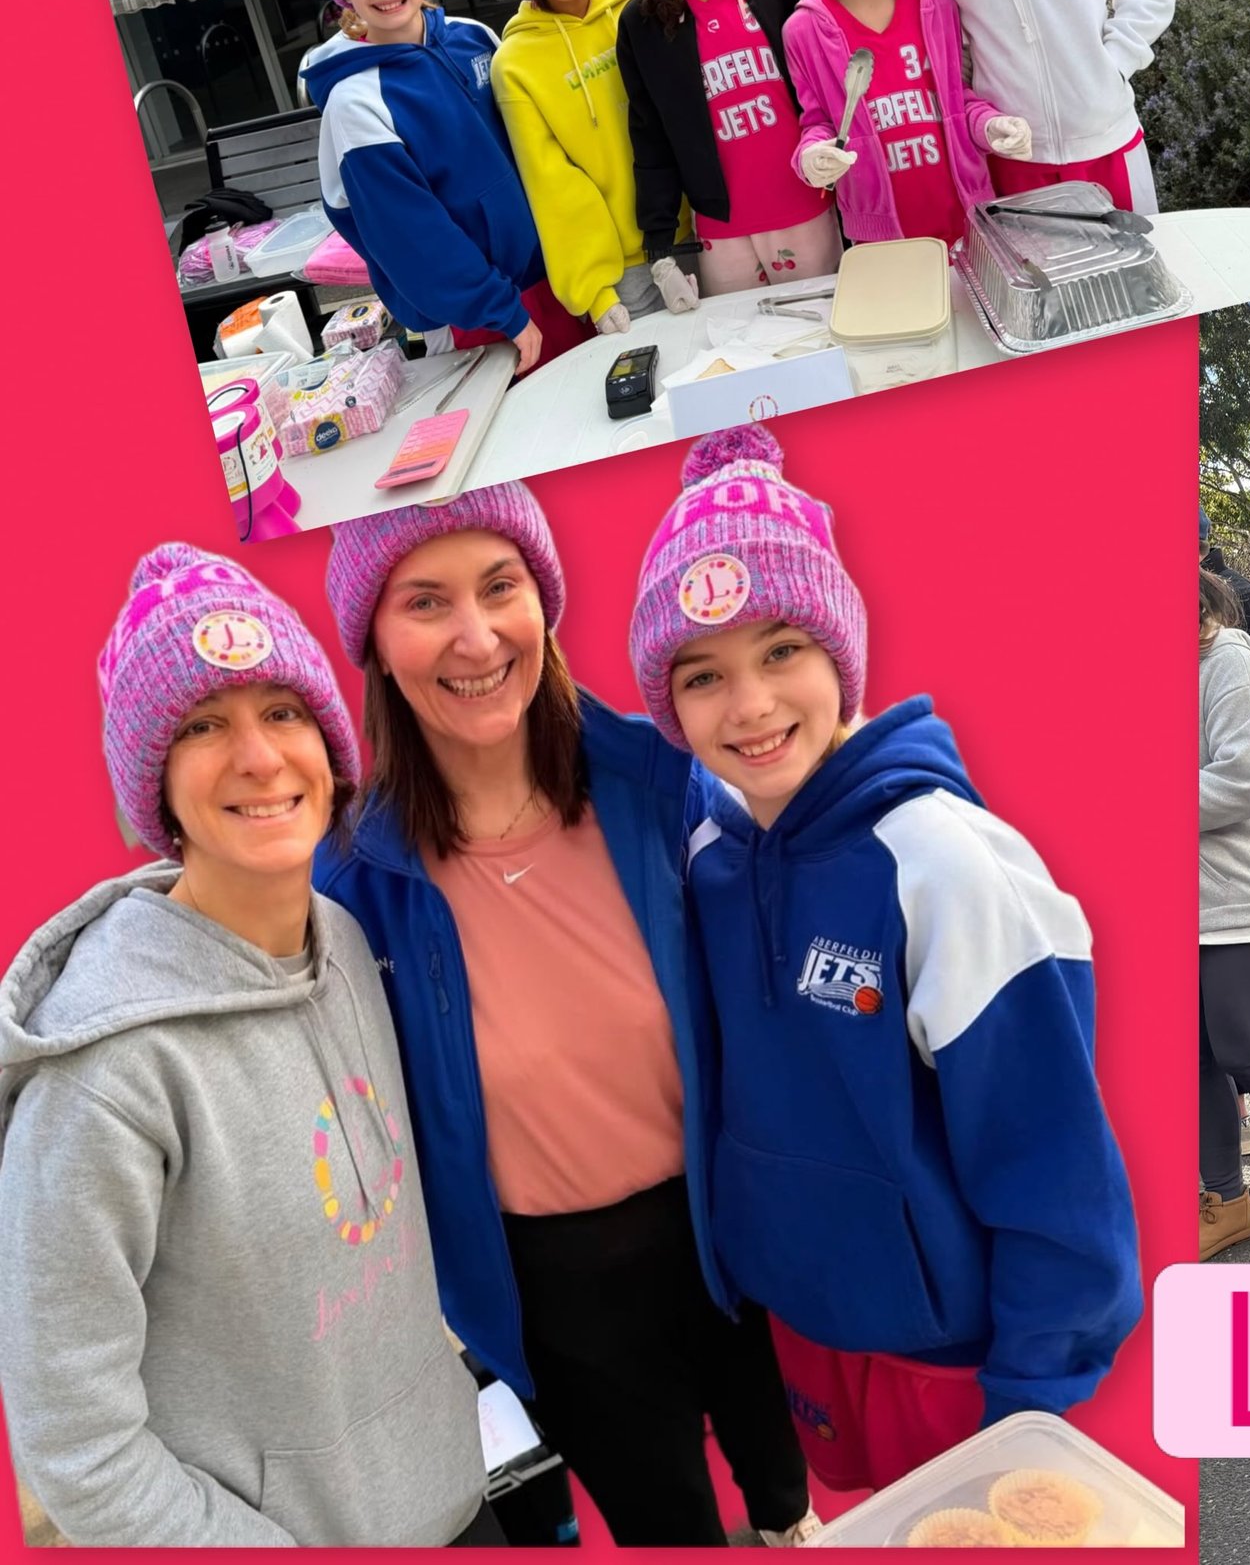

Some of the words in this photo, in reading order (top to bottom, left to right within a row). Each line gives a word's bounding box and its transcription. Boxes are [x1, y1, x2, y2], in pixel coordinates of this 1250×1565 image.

[900, 43, 931, 81] 3
[716, 94, 777, 142] JETS
[885, 133, 941, 172] JETS
[315, 425, 339, 443] deeko
[671, 480, 811, 534] FOR
[797, 945, 882, 995] JETS
